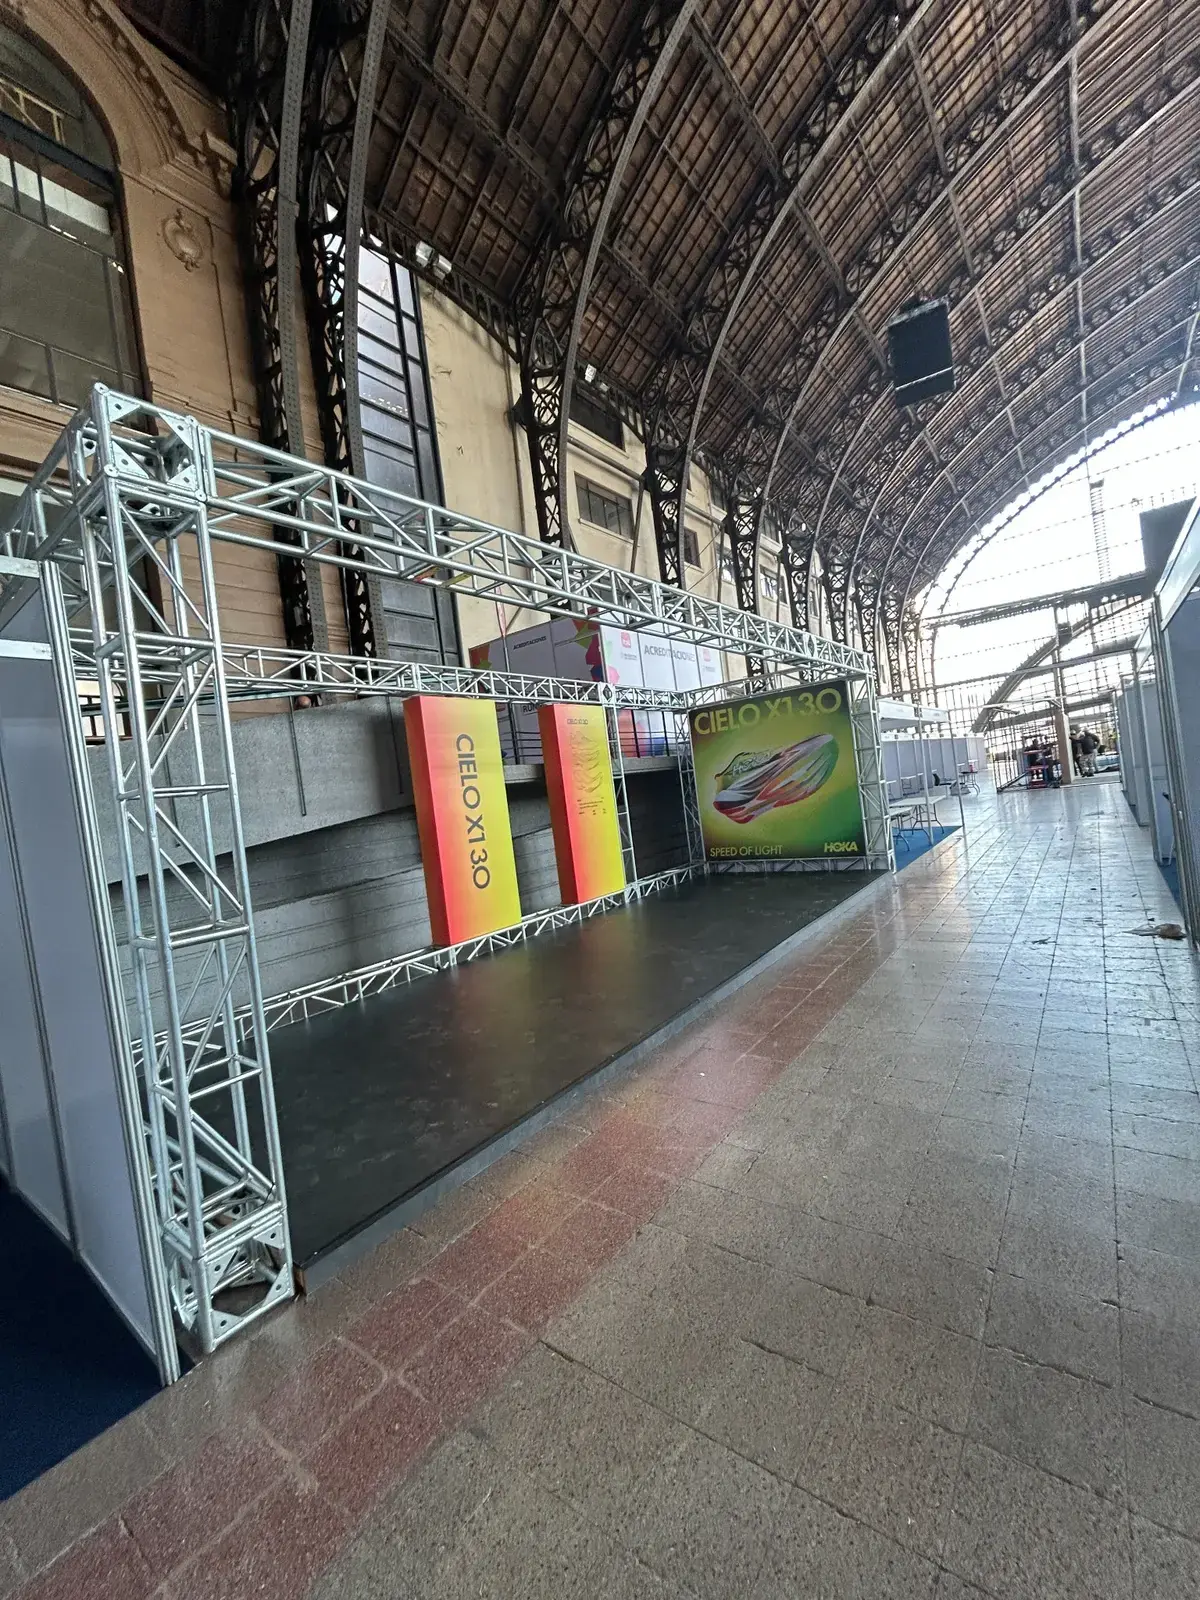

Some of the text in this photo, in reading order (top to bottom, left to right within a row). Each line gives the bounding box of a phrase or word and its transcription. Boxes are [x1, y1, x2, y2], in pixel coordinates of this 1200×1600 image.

[694, 687, 842, 735] CIELO X1 3.0
[456, 733, 491, 890] CIELO X1 3.0
[710, 844, 783, 857] SPEED OF LIGHT
[823, 841, 859, 853] HOKA
